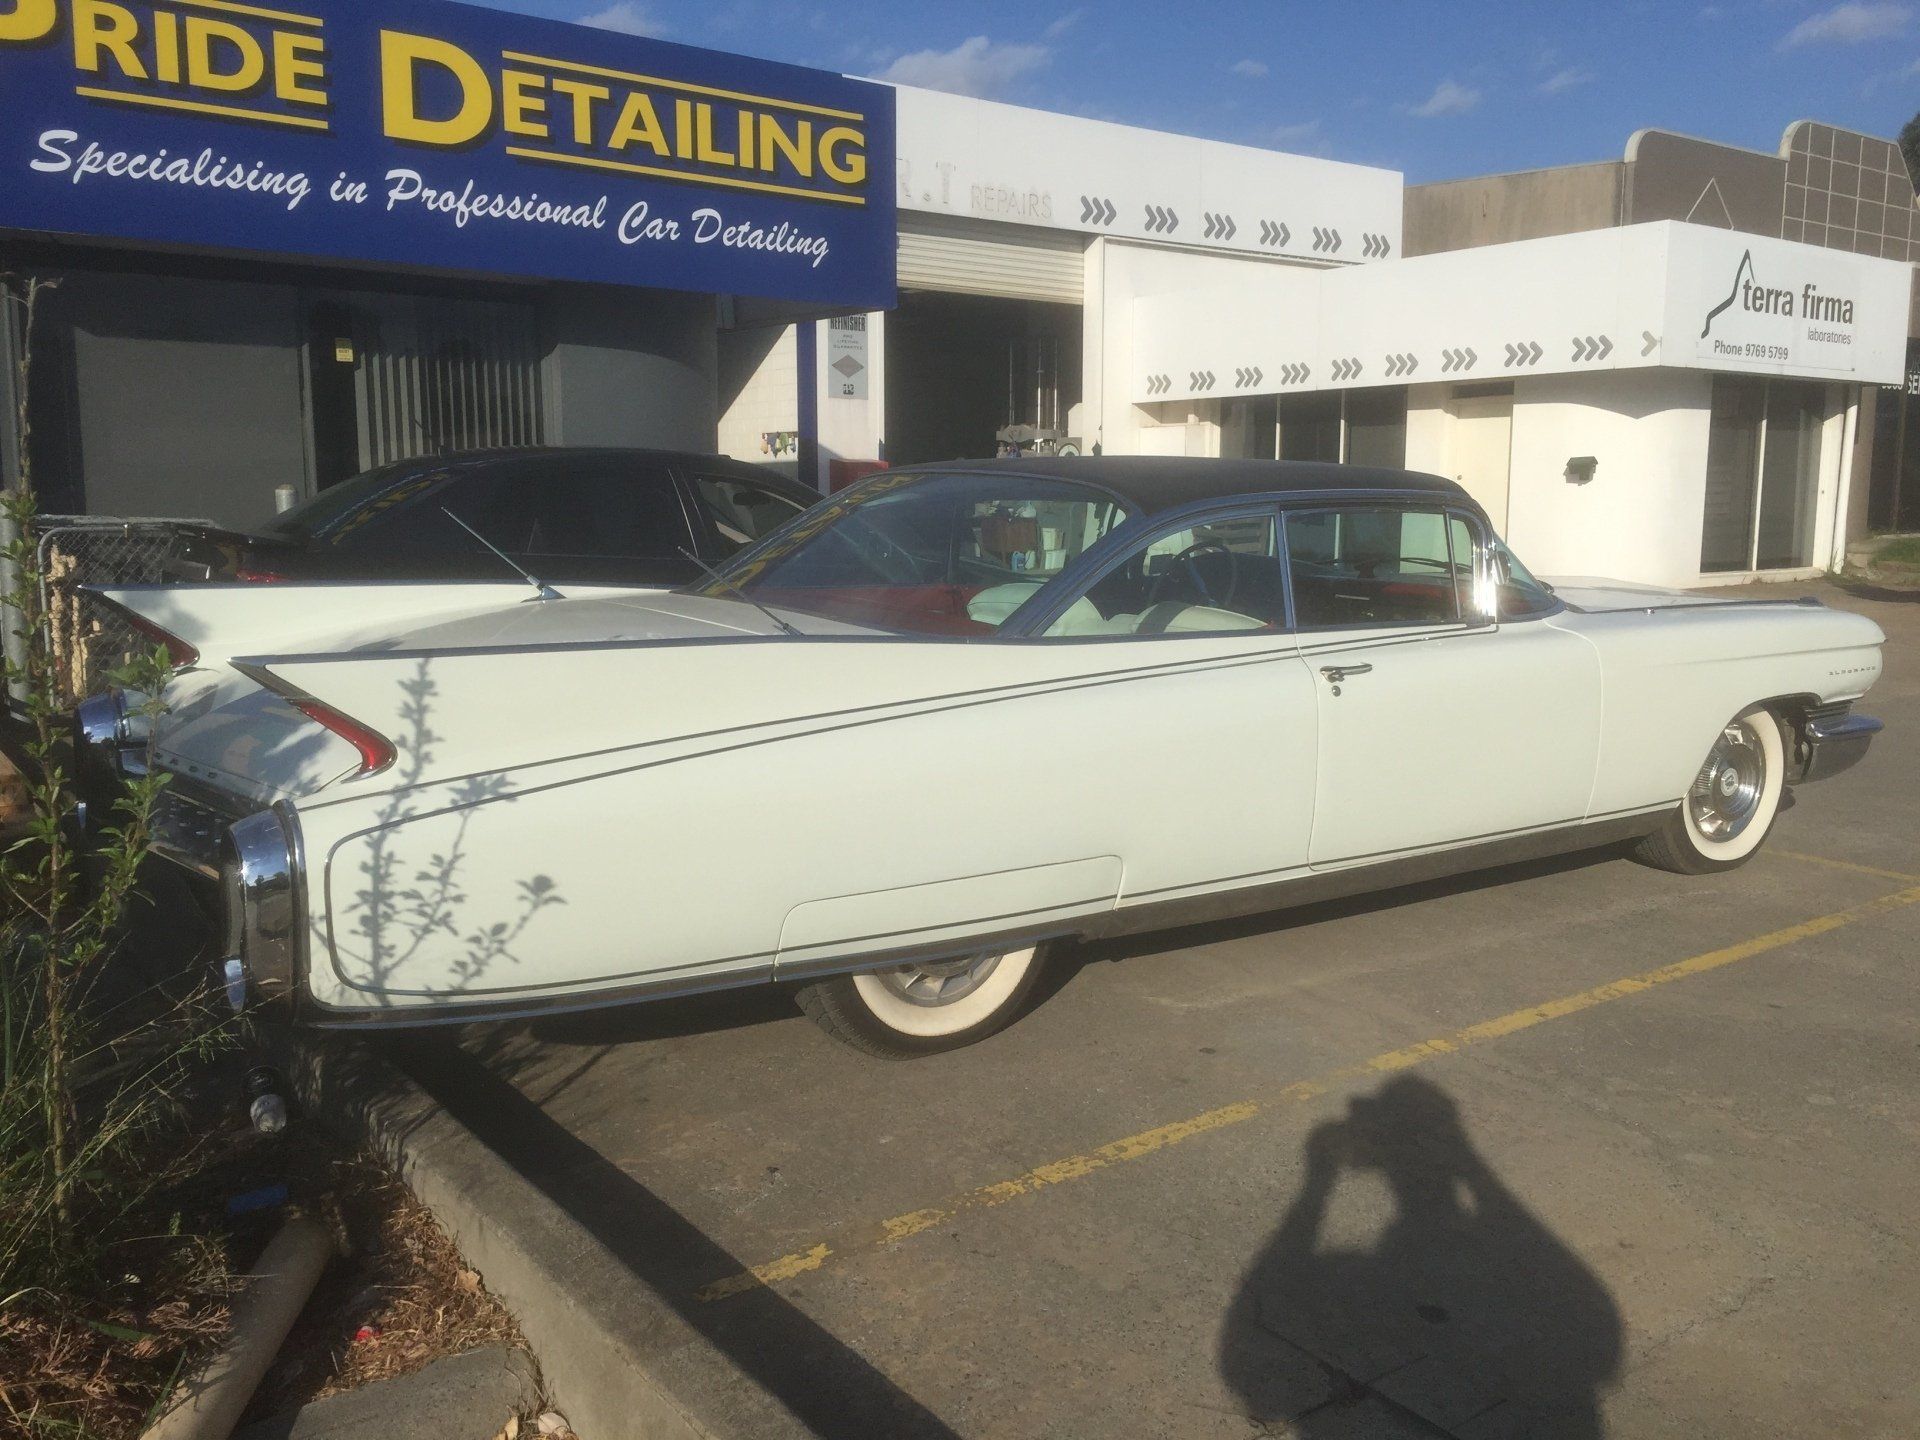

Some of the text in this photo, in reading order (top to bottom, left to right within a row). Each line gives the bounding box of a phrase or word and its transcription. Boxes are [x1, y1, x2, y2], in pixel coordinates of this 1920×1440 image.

[0, 0, 328, 106] RIDE
[29, 129, 830, 268] Specialising in Professional Car Detailing
[970, 184, 1053, 218] REPAIRS
[1742, 278, 1854, 325] terra firma
[1714, 339, 1789, 360] Phone 9769 5799
[1807, 327, 1852, 345] laboratories
[1907, 373, 1920, 395] SE
